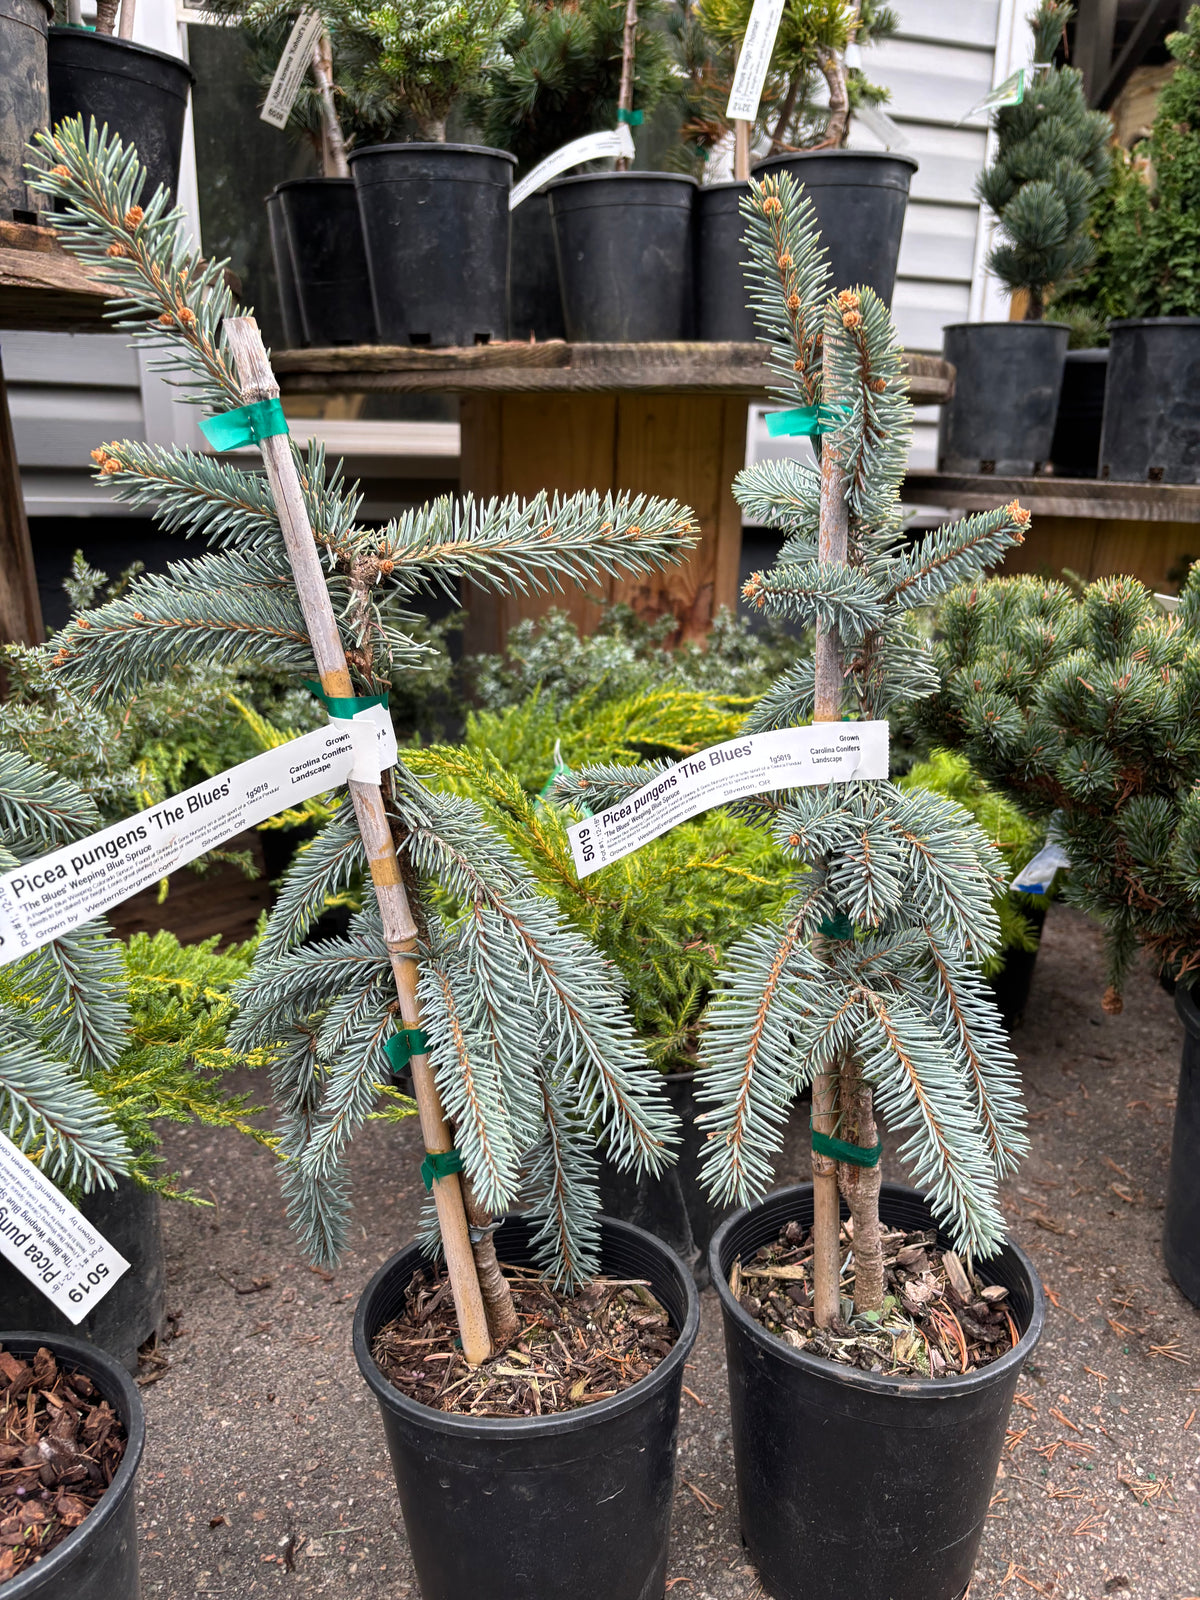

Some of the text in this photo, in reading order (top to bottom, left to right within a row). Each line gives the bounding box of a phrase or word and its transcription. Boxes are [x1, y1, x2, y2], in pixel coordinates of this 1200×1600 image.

[326, 734, 350, 747] Grown
[289, 745, 352, 774] Carolina Conifers
[291, 764, 331, 784] Landscape
[812, 756, 842, 764] Landscape
[246, 783, 268, 799] 1g5019
[603, 805, 631, 827] Picea
[634, 776, 677, 812] pungens
[678, 761, 706, 778] 'The
[709, 741, 752, 766] Blues'
[631, 808, 651, 823] Weeping
[651, 801, 662, 811] Blue
[662, 790, 680, 803] Spruce
[11, 778, 230, 898] Picea pungens 'The Blues'
[579, 829, 595, 861] 5019
[41, 885, 67, 903] Blues'
[69, 869, 106, 889] Weeping
[106, 859, 124, 871] Blue
[125, 845, 152, 861] Spruce
[36, 921, 66, 938] Grown
[67, 914, 78, 923] by
[6, 1197, 22, 1214] Blue
[21, 1210, 46, 1239] Weeping
[69, 1216, 78, 1227] by
[77, 1225, 95, 1245] Grown
[24, 1244, 61, 1283] Picea
[69, 1263, 109, 1302] 5019
